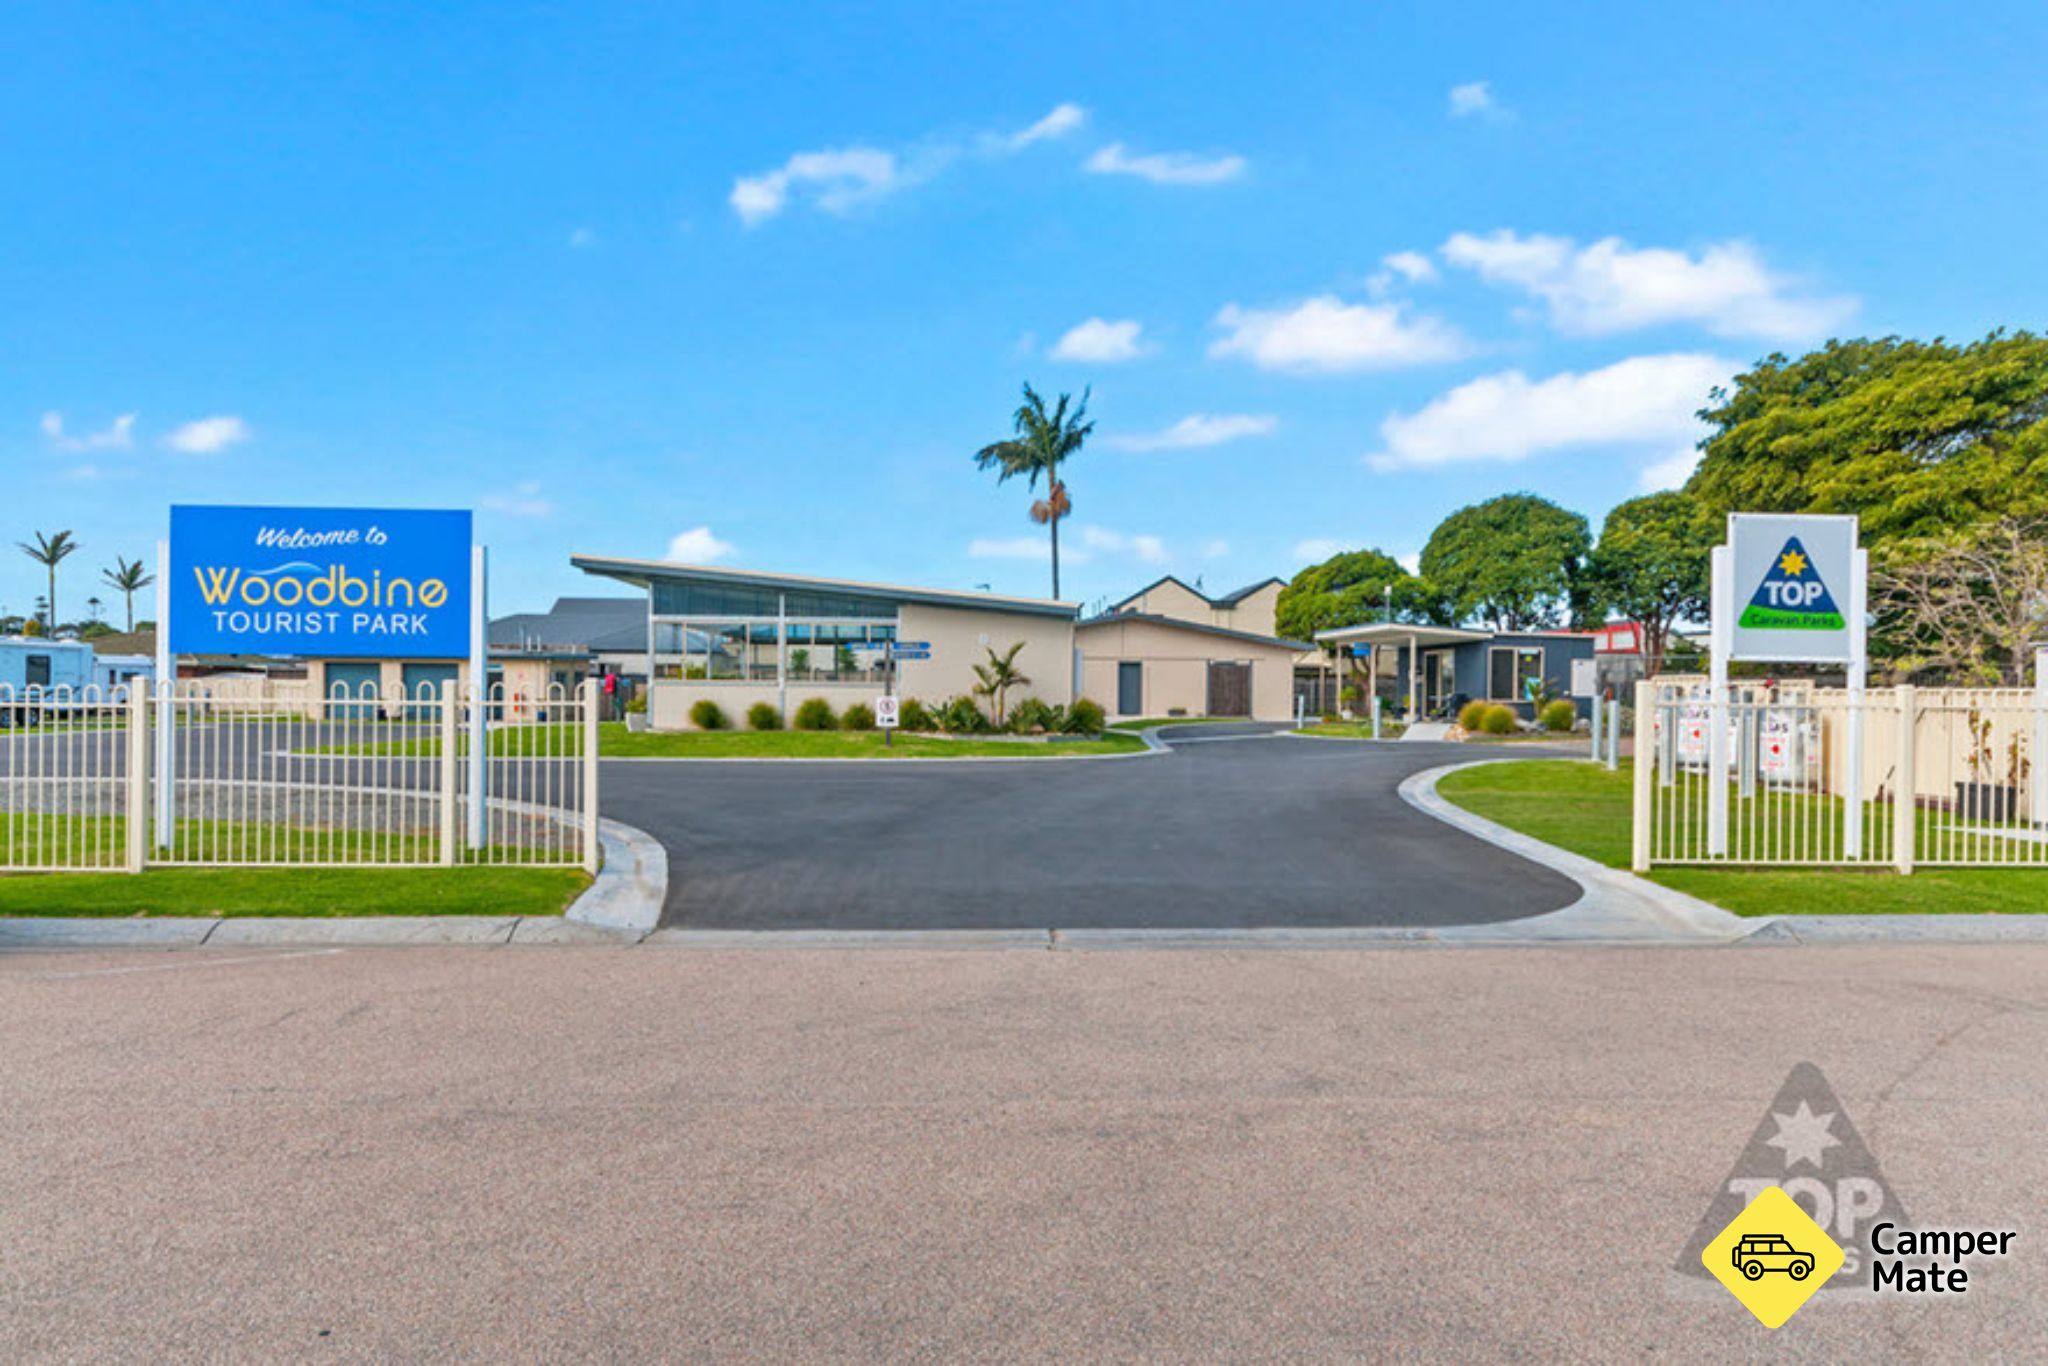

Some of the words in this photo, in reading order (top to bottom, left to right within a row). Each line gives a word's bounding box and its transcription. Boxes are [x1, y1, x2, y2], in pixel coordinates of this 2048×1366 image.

[256, 526, 360, 549] Welcome
[365, 526, 388, 546] to
[194, 564, 448, 608] Woodbine
[1763, 581, 1824, 606] TOP
[212, 611, 341, 634] TOURIST
[353, 613, 429, 635] PARK
[1751, 613, 1799, 625] Caravan
